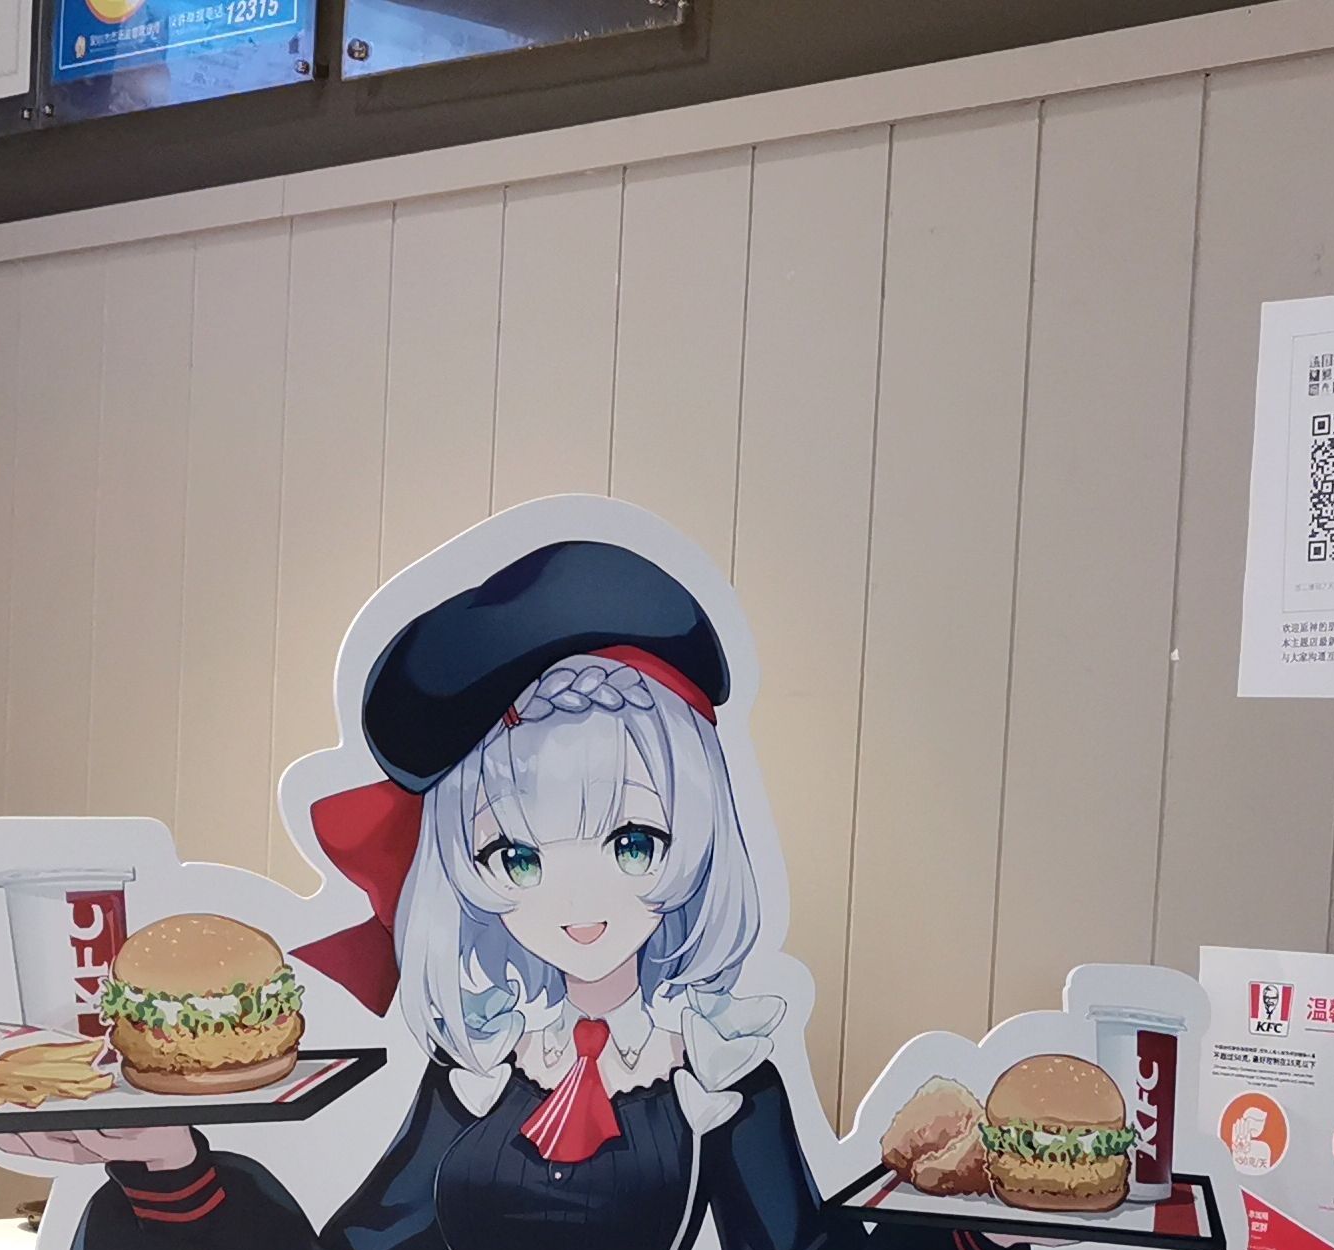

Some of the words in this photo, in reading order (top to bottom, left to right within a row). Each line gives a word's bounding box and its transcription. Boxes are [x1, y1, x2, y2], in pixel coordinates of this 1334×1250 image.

[226, 0, 278, 25] 12315
[67, 902, 108, 1015] KFC
[1255, 1020, 1283, 1034] KFC
[1134, 1056, 1159, 1161] KFC
